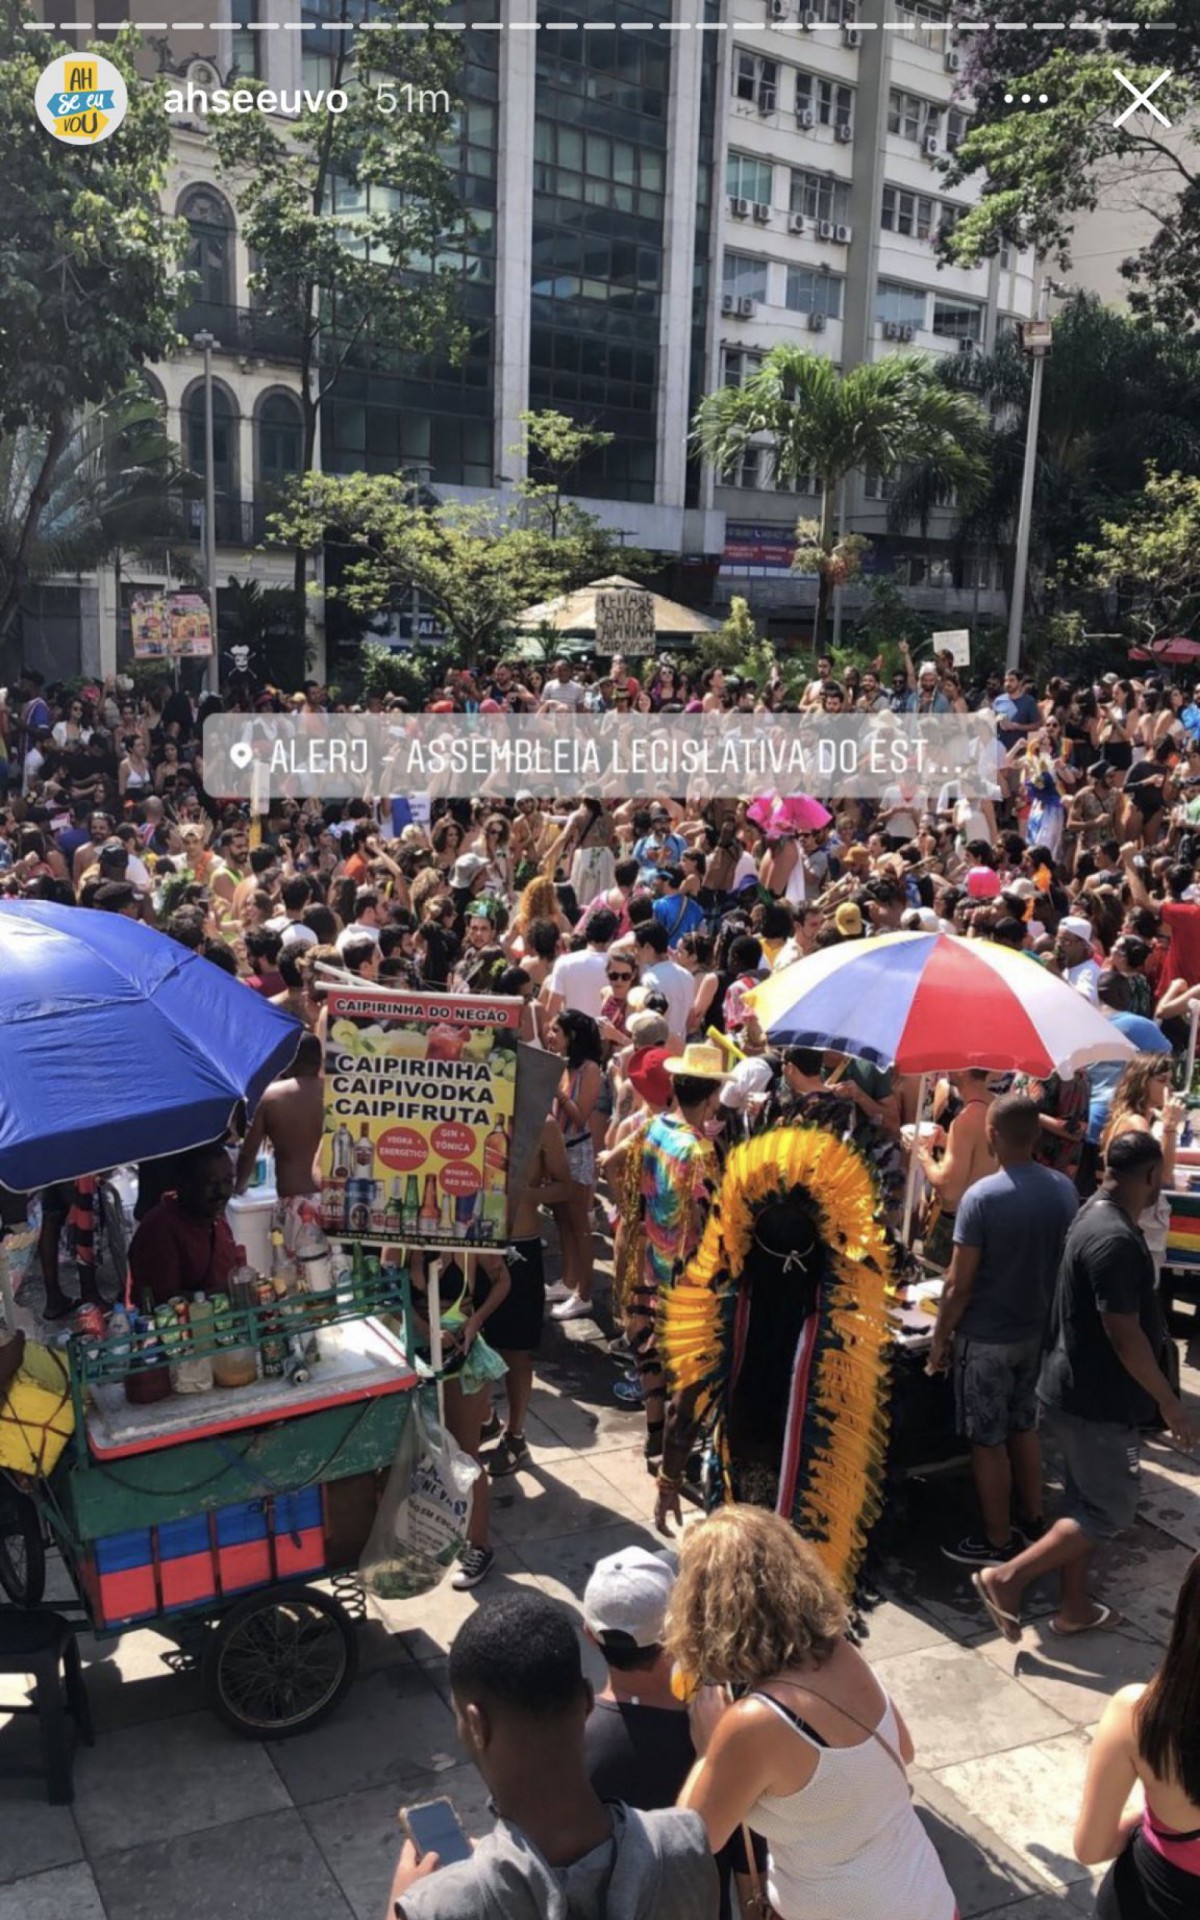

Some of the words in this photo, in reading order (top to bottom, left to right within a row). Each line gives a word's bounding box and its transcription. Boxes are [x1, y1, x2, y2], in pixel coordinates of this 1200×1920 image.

[336, 999, 425, 1016] CAIPIRINHA
[429, 1006, 450, 1018] DO
[455, 1007, 508, 1022] NEGÃO
[337, 1054, 492, 1082] CAIPIRINHA
[333, 1077, 495, 1104] CAIPIVODKA
[335, 1098, 490, 1125] CAIPIFRUTA
[440, 1128, 458, 1138] GIN
